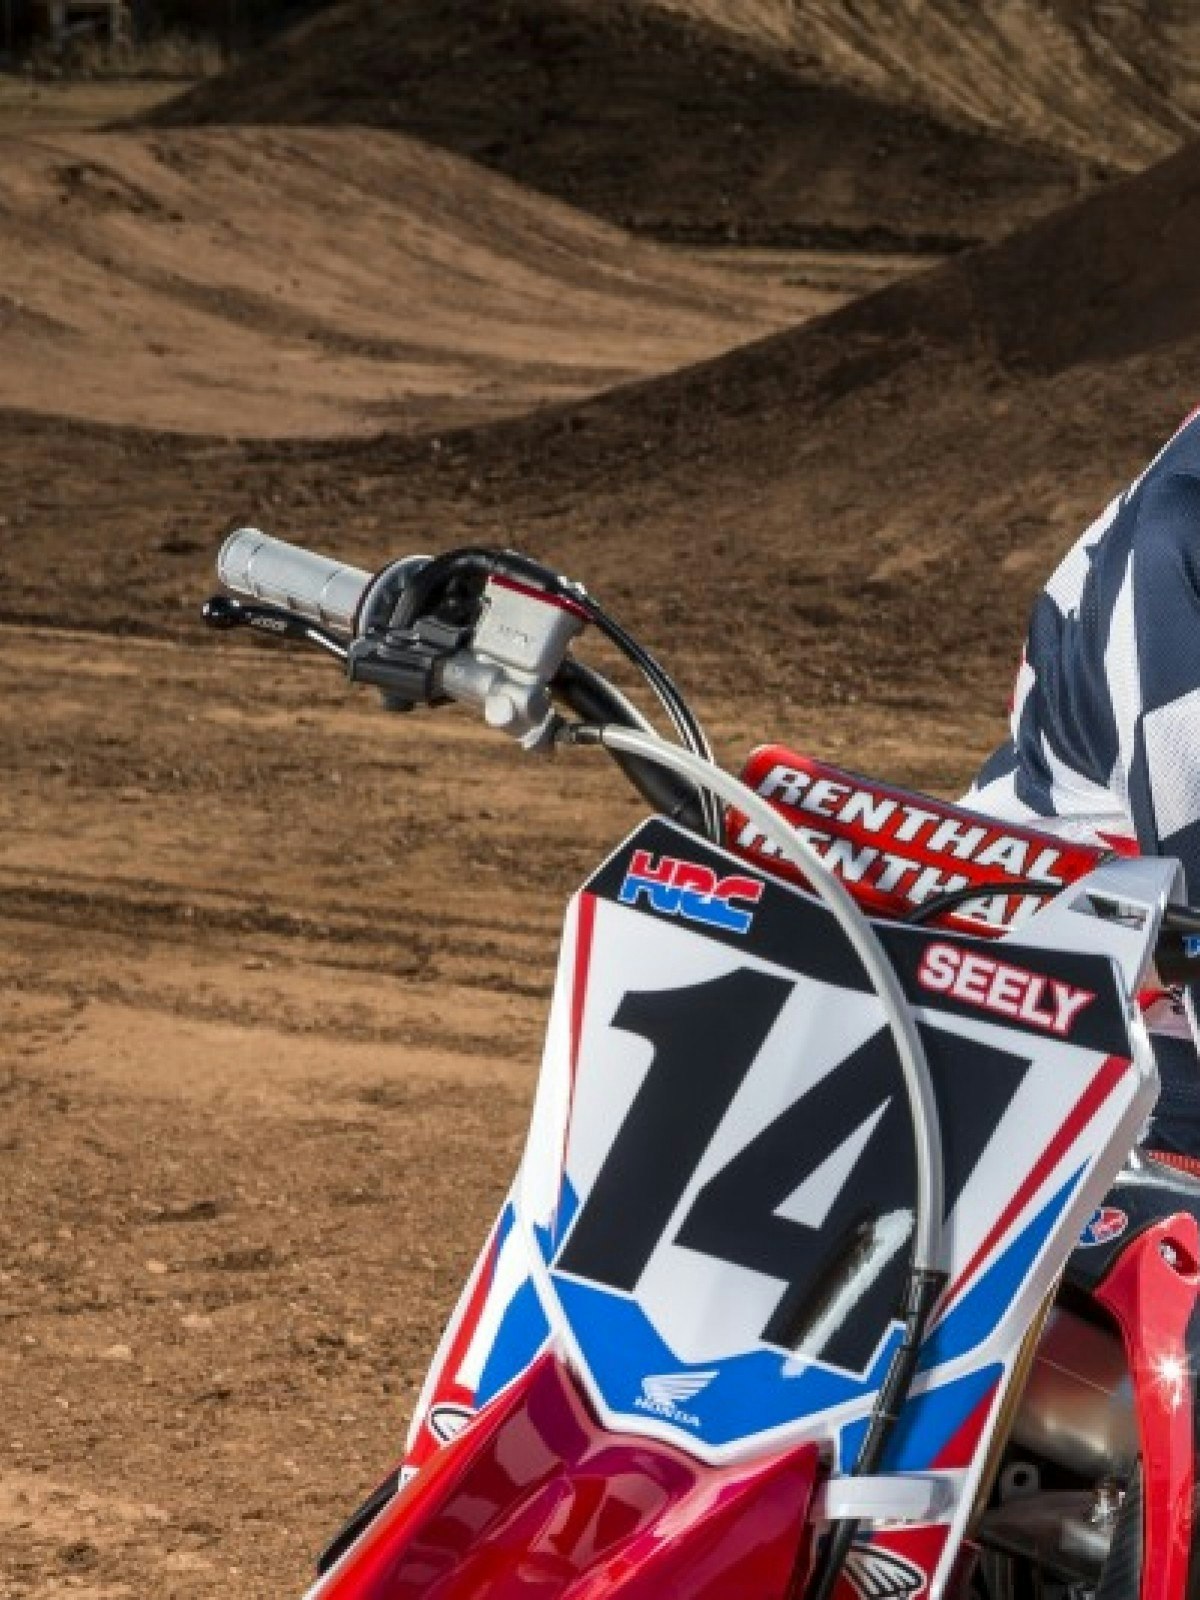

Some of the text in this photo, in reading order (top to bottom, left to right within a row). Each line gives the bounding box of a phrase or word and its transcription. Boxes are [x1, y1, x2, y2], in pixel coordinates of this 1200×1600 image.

[758, 764, 1064, 884] RENTHAL
[917, 942, 1096, 1036] SEELY
[551, 965, 1033, 1377] 14
